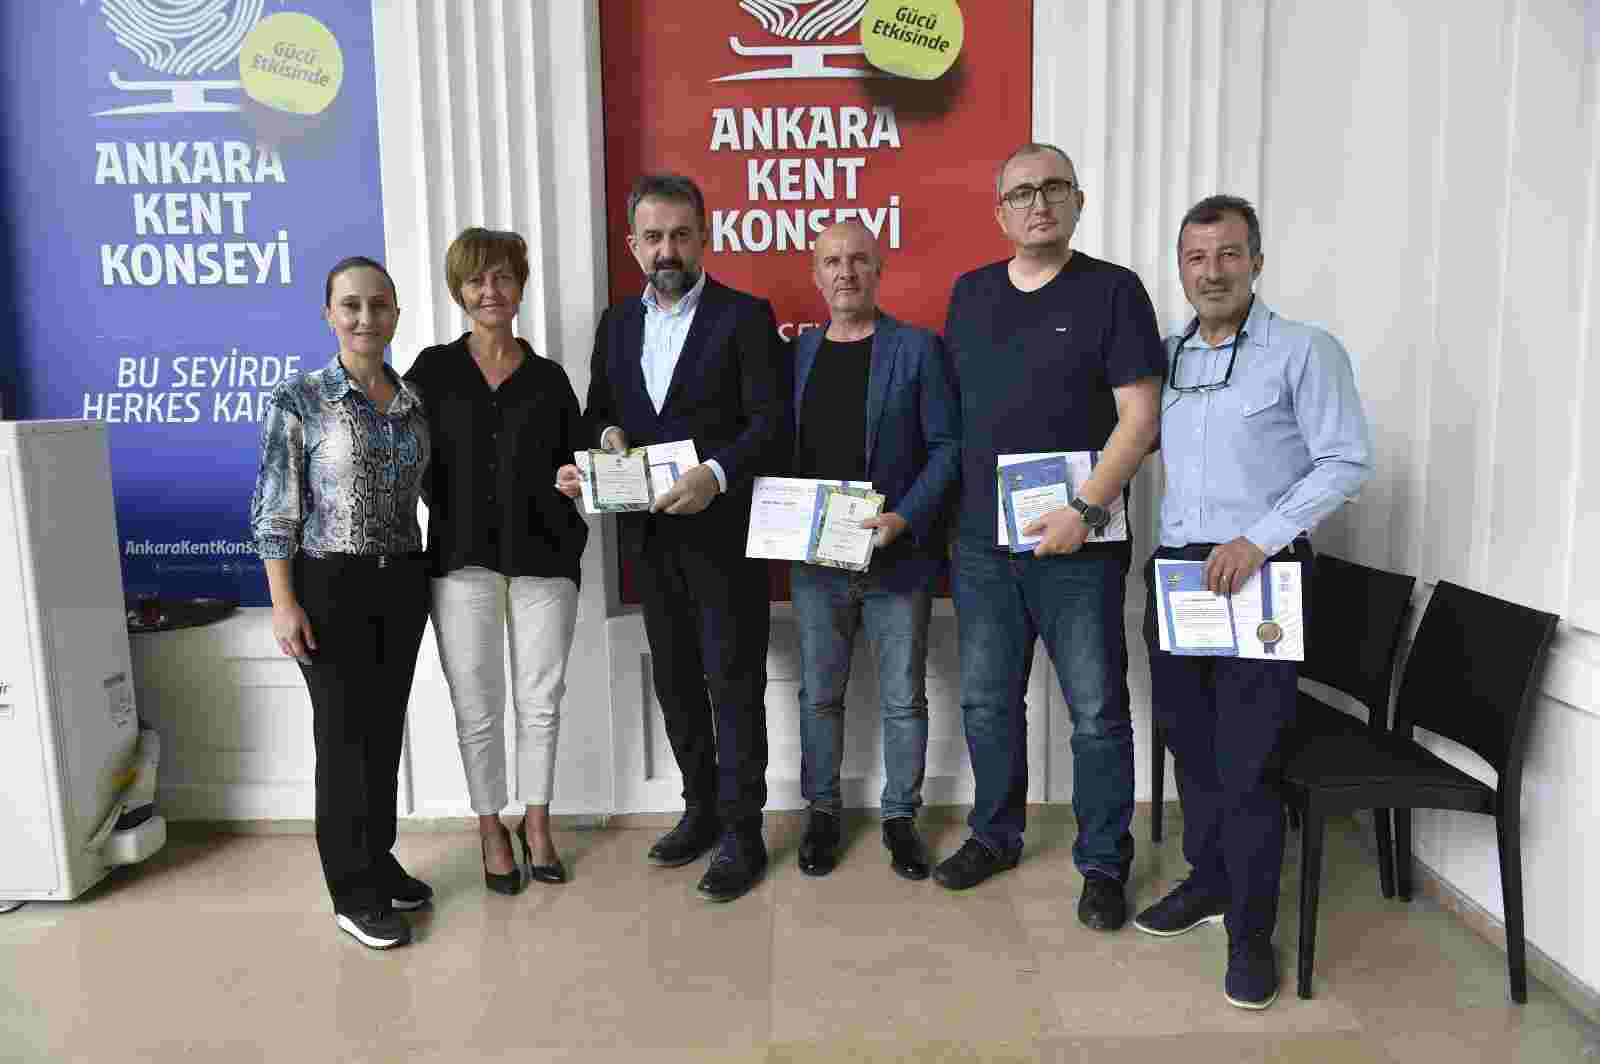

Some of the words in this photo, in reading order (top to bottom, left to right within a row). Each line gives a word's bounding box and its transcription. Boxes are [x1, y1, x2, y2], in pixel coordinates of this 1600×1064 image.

[871, 18, 950, 52] Etkisinde
[895, 6, 937, 30] Gücü
[710, 106, 901, 150] ANKARA
[95, 141, 286, 184] ANKARA
[747, 157, 866, 201] KENT
[133, 192, 252, 235] KENT
[101, 230, 292, 285] KONSEYİ
[117, 357, 160, 388] BU
[171, 348, 301, 387] SEYİRDE
[82, 392, 201, 423] HERKES
[125, 540, 258, 555] AnkaraKentKons
